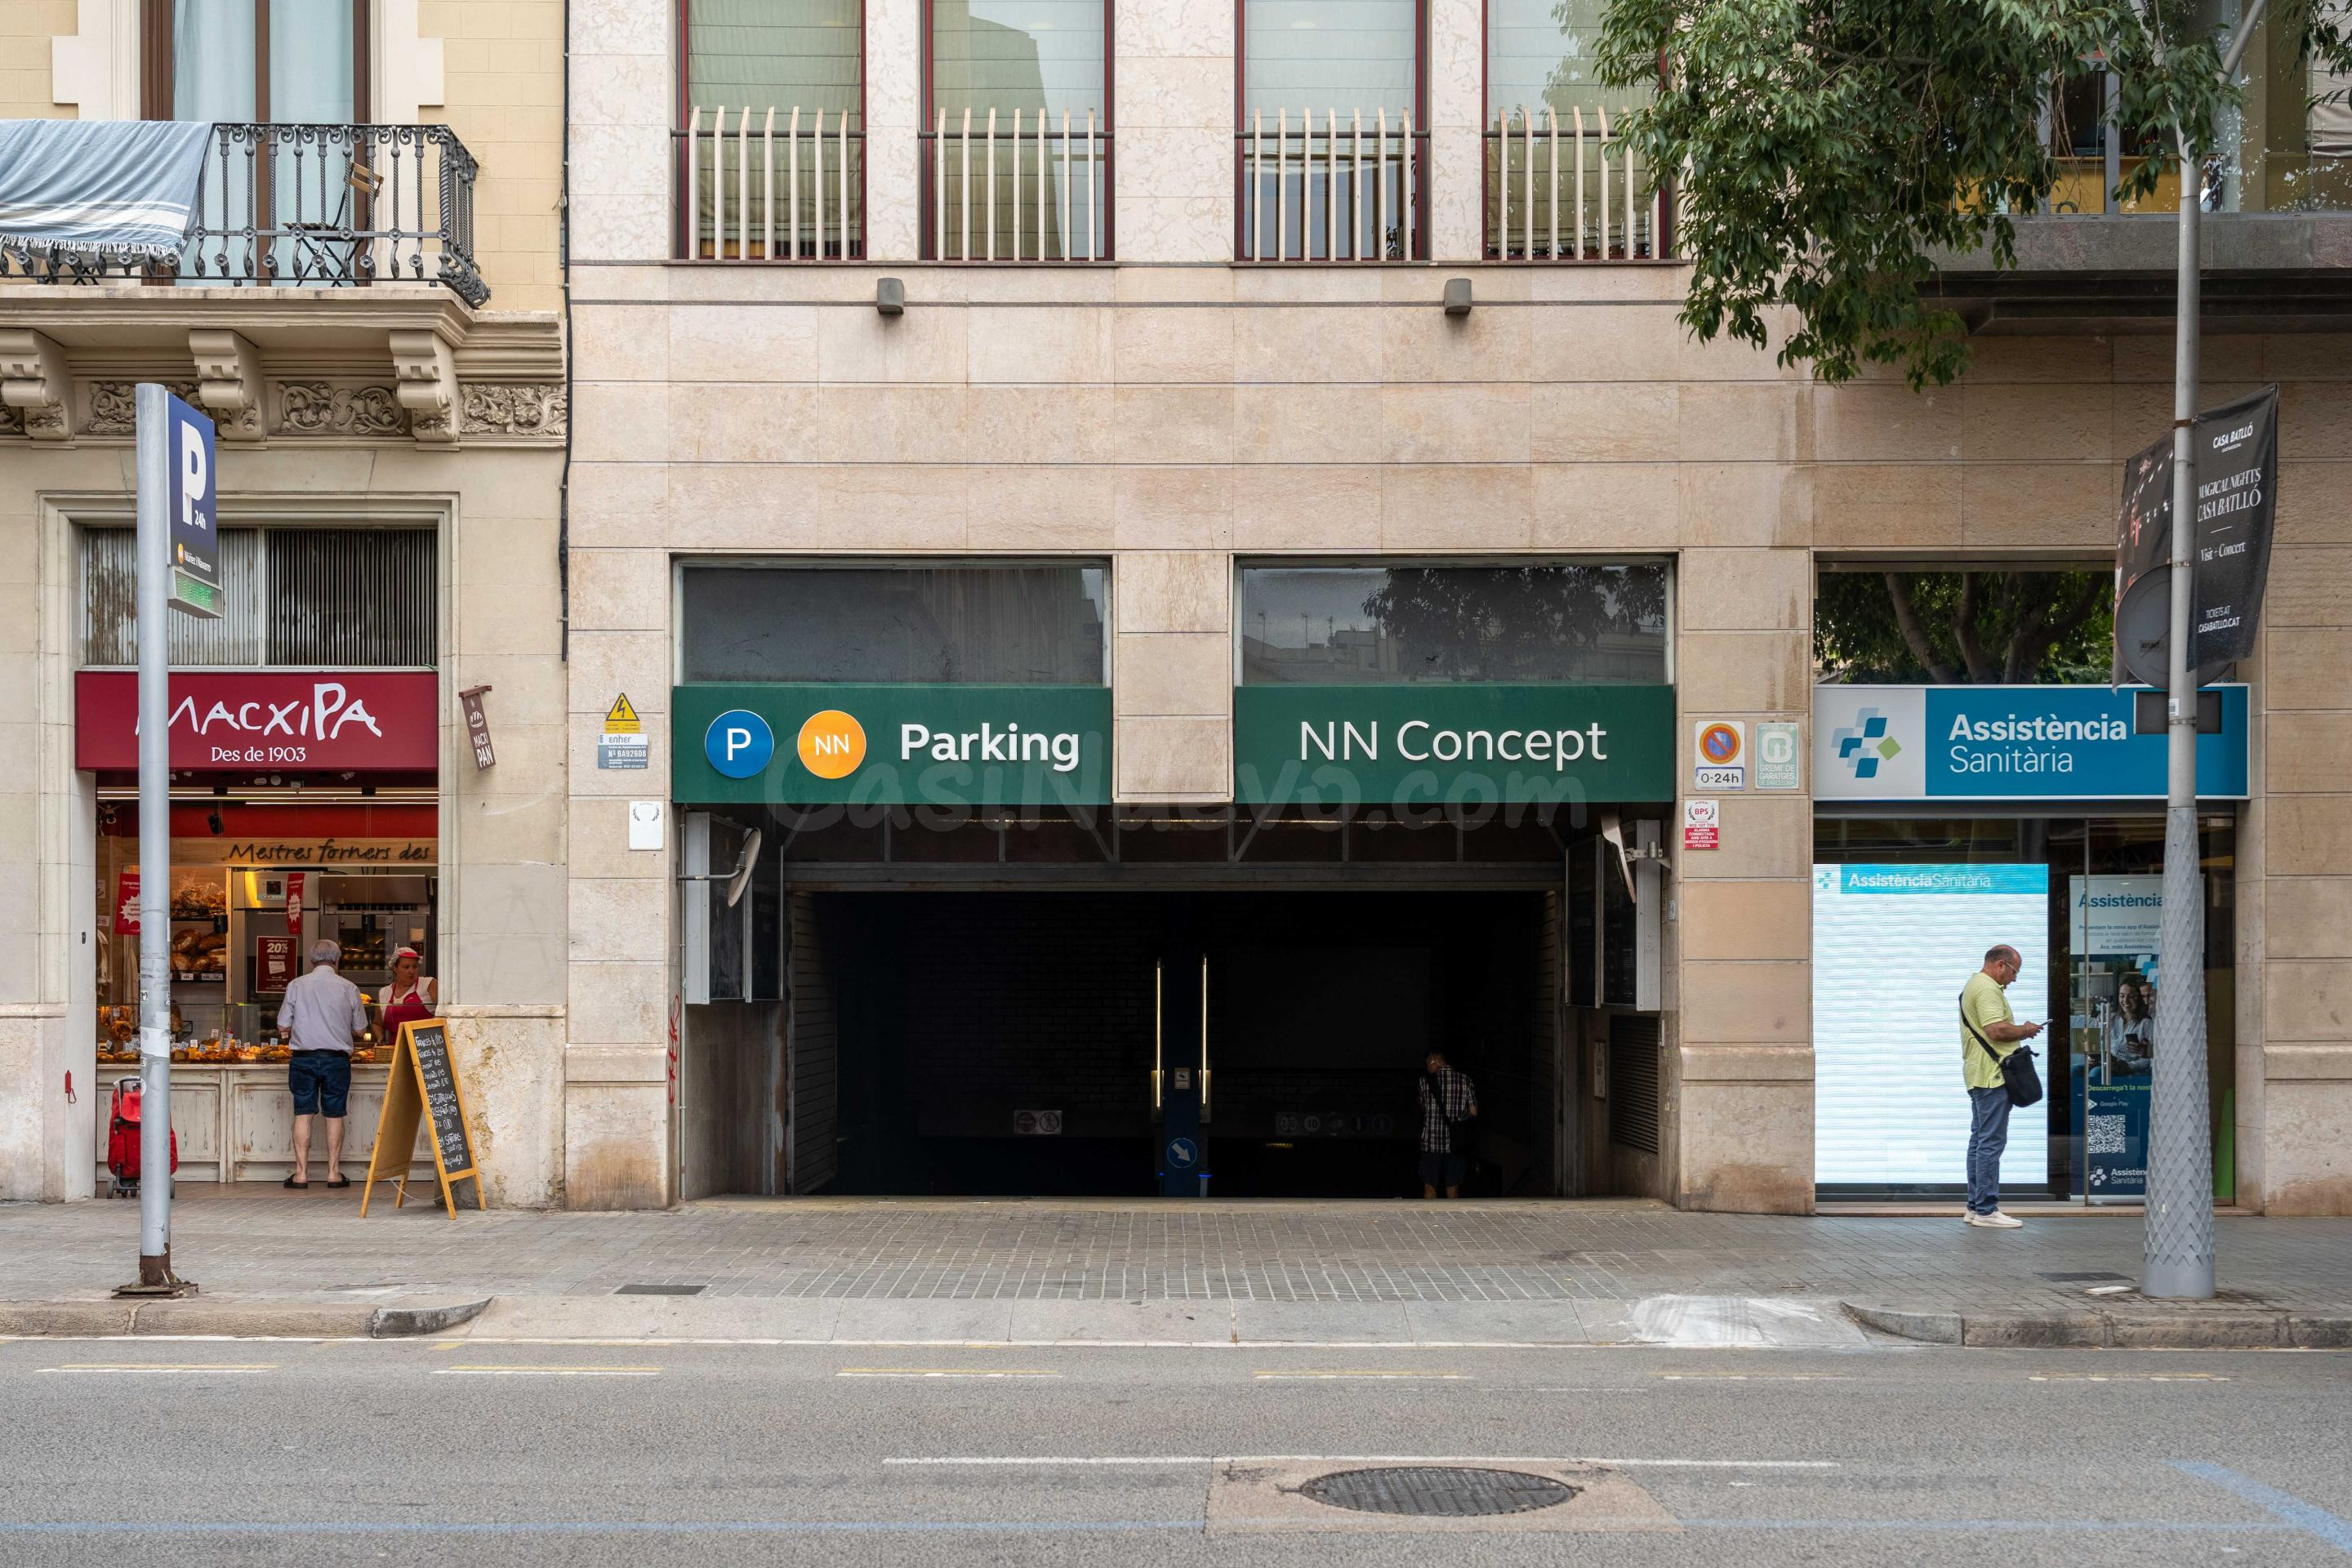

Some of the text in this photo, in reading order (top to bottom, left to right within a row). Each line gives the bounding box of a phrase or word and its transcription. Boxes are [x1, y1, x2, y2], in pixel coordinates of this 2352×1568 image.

[2213, 421, 2253, 449] CASA BATLLÓ
[181, 420, 207, 526] P
[2198, 468, 2261, 498] MAGICAL NIGHTS
[2197, 483, 2261, 522] CASA BATLLÓ
[194, 510, 207, 530] 24h
[2201, 547, 2213, 562] Visit
[2219, 541, 2246, 557] Concert
[2206, 607, 2225, 619] TICKETS
[608, 735, 631, 743] enher
[1949, 713, 2127, 742] Assistència
[211, 746, 306, 762] Des de 1903
[476, 744, 493, 768] PAN
[726, 728, 751, 761] P
[814, 733, 850, 756] NN
[901, 723, 1080, 773] Parking
[1300, 719, 1608, 772] NN Concept
[1760, 764, 1781, 773] GREMI
[1949, 744, 2074, 773] Sanitària
[1701, 773, 1739, 783] 0-24h
[229, 838, 430, 863] Mestres forners des
[2078, 893, 2163, 907] Assistència
